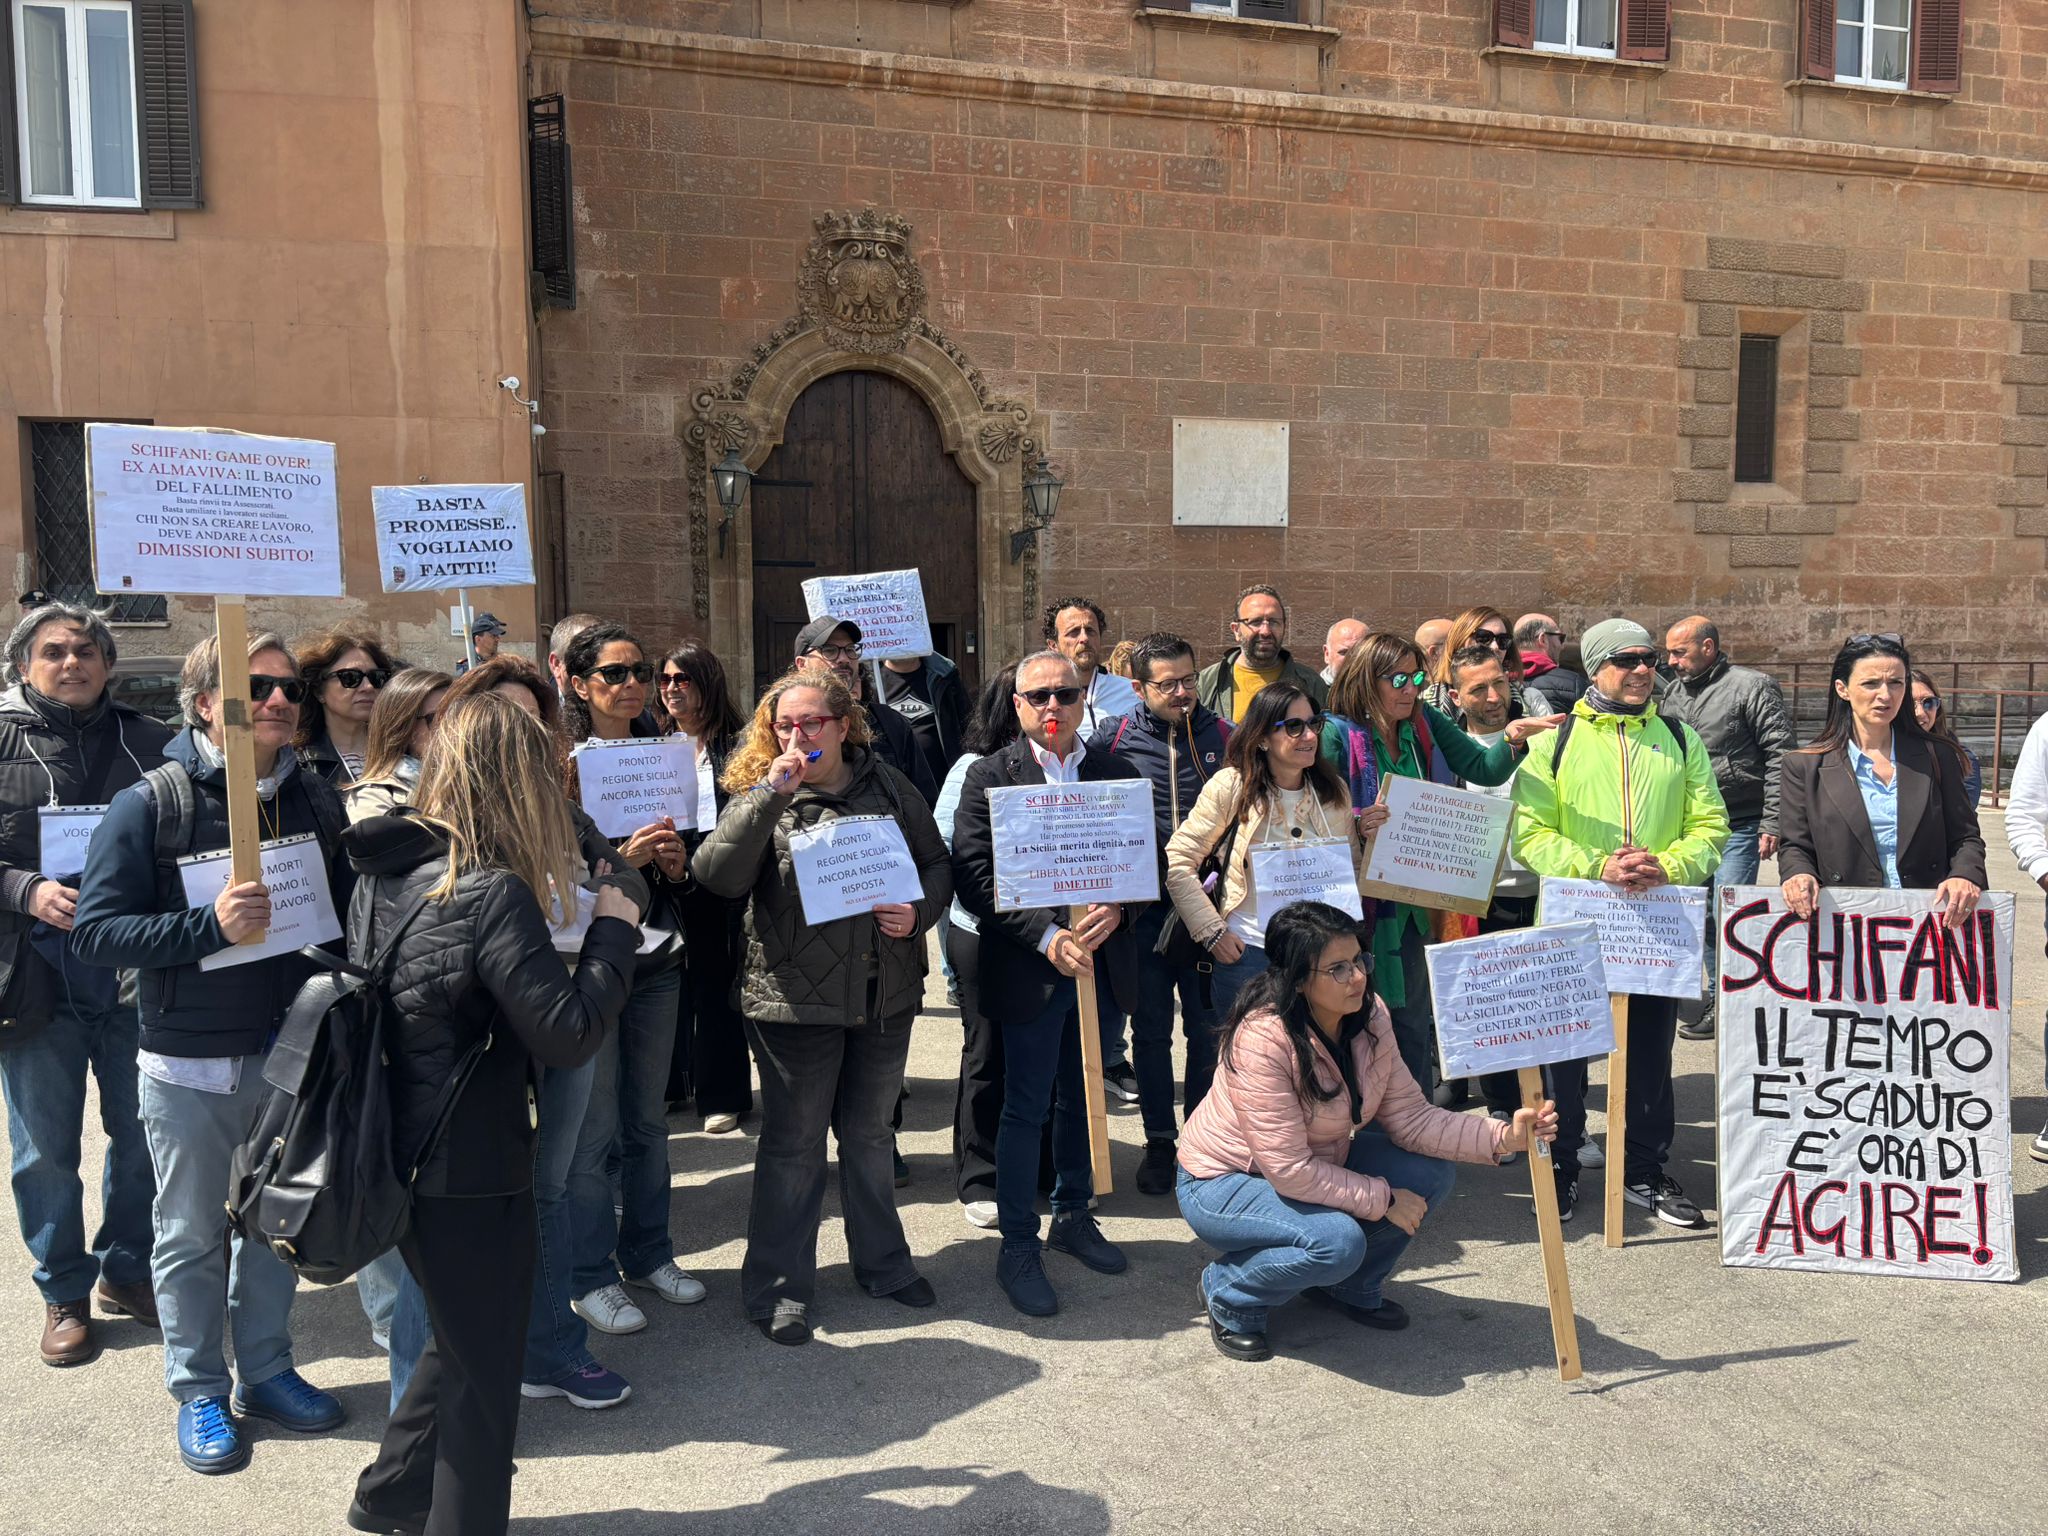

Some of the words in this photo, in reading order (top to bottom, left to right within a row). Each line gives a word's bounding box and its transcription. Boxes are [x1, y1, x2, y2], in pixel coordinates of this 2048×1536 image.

[131, 444, 211, 461] SCHIFANI:
[216, 451, 261, 465] GAME
[266, 455, 311, 469] OVER!
[122, 461, 144, 473] EX
[149, 463, 241, 480] ALMAVIVA:
[246, 471, 260, 482] IL
[264, 472, 321, 486] BACINO
[156, 480, 188, 493] DEL
[193, 483, 292, 500] FALLIMENTO
[162, 505, 184, 513] Basta
[185, 507, 217, 515] umiliare
[223, 508, 258, 517] lavoratori
[417, 498, 487, 511] BASTA
[136, 514, 158, 524] CHI
[162, 516, 189, 525] NON
[192, 517, 208, 526] SA
[212, 519, 258, 530] CREARE
[262, 521, 313, 533] LAVORO,
[389, 518, 516, 533] PROMESSE..
[158, 528, 191, 539] DEVE
[196, 530, 247, 542] ANDARE
[250, 533, 259, 542] A
[261, 534, 294, 544] CASA.
[138, 542, 241, 559] DIMISSIONI
[246, 548, 313, 562] SUBITO!
[398, 539, 513, 555] VOGLIAMO
[420, 561, 496, 576] FATTI!!
[847, 583, 882, 592] BASTA
[836, 610, 852, 618] LA
[854, 604, 902, 614] REGIONE
[871, 615, 913, 625] QUELLO
[862, 629, 877, 638] HE
[619, 756, 661, 766] PRONTO?
[603, 775, 644, 784] REGIONE
[646, 771, 678, 781] SICILIA?
[601, 792, 641, 802] ANCORA
[644, 786, 682, 797] NESSUNA
[1026, 794, 1086, 806] SCHIFANI:
[1420, 792, 1433, 801] 400
[1434, 795, 1471, 810] FAMIGLIE
[1474, 804, 1485, 812] EX
[624, 802, 666, 814] RISPOSTA
[1409, 802, 1453, 818] ALMAVIVA
[1455, 810, 1489, 824] TRADITE
[1056, 822, 1084, 831] promesso
[1404, 812, 1429, 824] Progetti
[1464, 825, 1489, 835] FERMI
[832, 832, 871, 848] PRONTO?
[1052, 833, 1078, 841] prodotto
[1409, 825, 1428, 834] nostro
[1453, 834, 1486, 846] NEGATO
[1015, 845, 1027, 854] La
[1030, 844, 1057, 853] Sicilia
[1060, 841, 1090, 850] merita
[1093, 839, 1126, 850] dignità,
[1389, 832, 1399, 841] LA
[1402, 835, 1430, 847] SICILIA
[1433, 840, 1449, 850] NON
[1458, 847, 1469, 855] UN
[1471, 848, 1492, 859] CALL
[817, 851, 858, 868] REGIONE
[860, 846, 890, 858] SICILIA?
[1054, 855, 1108, 864] chiacchiere.
[1400, 846, 1431, 858] CENTER
[1433, 853, 1441, 861] IN
[1443, 855, 1476, 867] ATTESA!
[268, 859, 303, 875] MORTI
[818, 870, 857, 884] ANCORA
[860, 860, 899, 875] NESSUNA
[1029, 869, 1067, 880] LIBERA
[1087, 864, 1134, 875] REGIONE.
[1393, 856, 1435, 872] SCHIFANI,
[1438, 865, 1477, 879] VATTENE
[301, 877, 310, 886] IL
[1306, 871, 1333, 880] SICILIA?
[842, 878, 885, 894] RISPOSTA
[1053, 878, 1112, 891] DIMETTITI!
[1302, 883, 1338, 894] NESSUNA
[275, 893, 316, 911] LAVORO
[1560, 888, 1575, 896] 400
[1577, 890, 1624, 900] FAMIGLIE
[1643, 894, 1696, 904] ALMAVIVA
[1606, 902, 1648, 912] TRADITE
[1575, 911, 1605, 920] Progetti
[1649, 916, 1678, 924] FERMI
[1639, 927, 1679, 935] NEGATO
[1614, 935, 1636, 943] NON
[1664, 938, 1689, 947] CALL
[1474, 950, 1493, 961] 400
[1495, 941, 1549, 956] FAMIGLIE
[1551, 938, 1566, 947] EX
[1619, 945, 1628, 953] IN
[1631, 947, 1672, 956] ATTESA!
[1722, 899, 1999, 1010] SCHIFANI
[1467, 960, 1528, 977] ALMAVIVA
[1530, 951, 1577, 966] TRADITE
[1627, 957, 1675, 968] VATTENE
[1465, 978, 1501, 992] Progetti
[1504, 971, 1549, 986] (116117):
[1551, 964, 1582, 976] FERMI
[1467, 997, 1473, 1006] Il
[1477, 994, 1505, 1004] nostro
[1508, 988, 1538, 999] futuro:
[1542, 978, 1587, 993] NEGATO
[1455, 1012, 1470, 1022] LA
[1474, 1006, 1514, 1019] SICILIA
[1518, 1001, 1541, 1012] NON
[1555, 995, 1570, 1005] UN
[1573, 990, 1600, 1002] CALL
[1476, 1019, 1521, 1033] CENTER
[1525, 1015, 1536, 1025] IN
[1539, 1007, 1584, 1023] ATTESA!
[1473, 1032, 1535, 1048] SCHIFANI,
[1538, 1020, 1591, 1037] VATTENE
[1754, 1007, 1803, 1067] IL
[1812, 1009, 1992, 1078] TEMPO
[1803, 1077, 1992, 1132] SCADUTO
[1858, 1134, 1925, 1180] ORA
[1937, 1137, 1981, 1180] DI
[1755, 1171, 1993, 1265] AGIRE!
